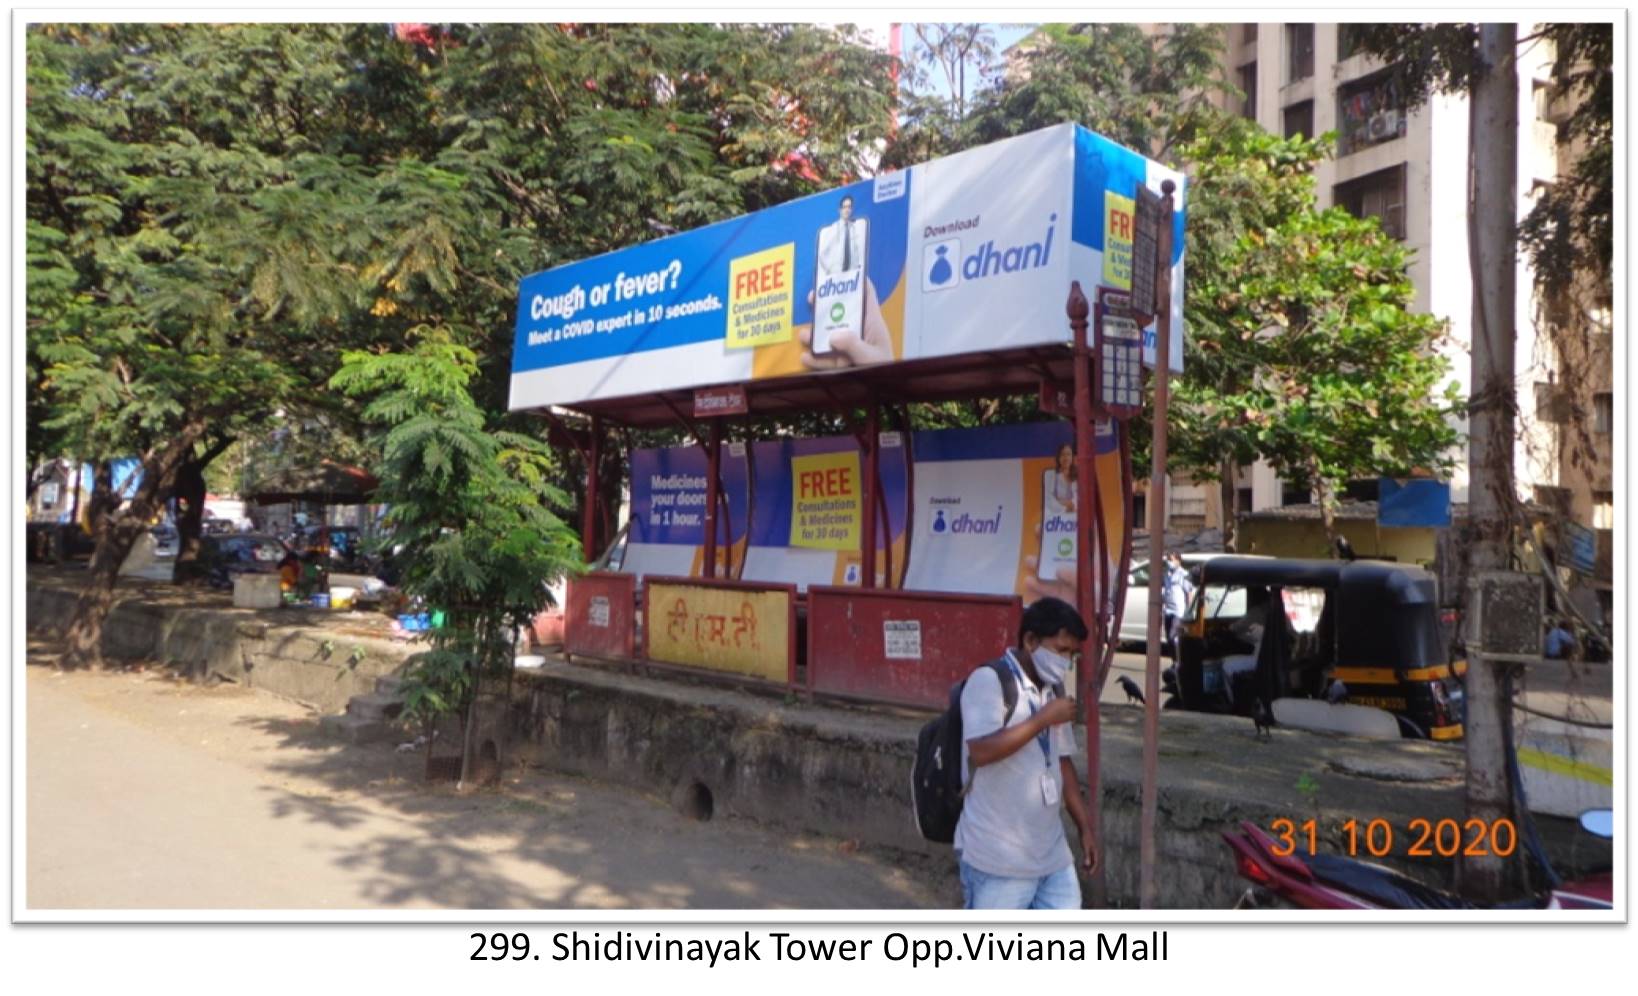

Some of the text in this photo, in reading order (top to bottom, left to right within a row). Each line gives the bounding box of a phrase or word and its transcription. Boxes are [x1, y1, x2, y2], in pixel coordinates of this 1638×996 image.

[923, 215, 981, 238] Download
[962, 213, 1057, 280] dhani
[530, 259, 682, 321] Cough or fever?
[735, 260, 785, 300] FREE
[818, 264, 862, 297] dhani
[733, 292, 788, 314] Consultations
[528, 294, 722, 346] Meet a COVID expert in 10 seconds.
[743, 307, 785, 323] Medicines
[737, 327, 749, 339] for
[763, 321, 782, 335] days
[651, 474, 707, 489] Medicines
[800, 467, 852, 499] FREE
[651, 493, 675, 509] your
[797, 499, 856, 513] Consultations
[650, 510, 701, 525] in 1 hour.
[809, 513, 853, 526] Medicines
[951, 505, 1003, 534] dhani
[1045, 516, 1077, 533] dha
[802, 527, 849, 541] for 30 days
